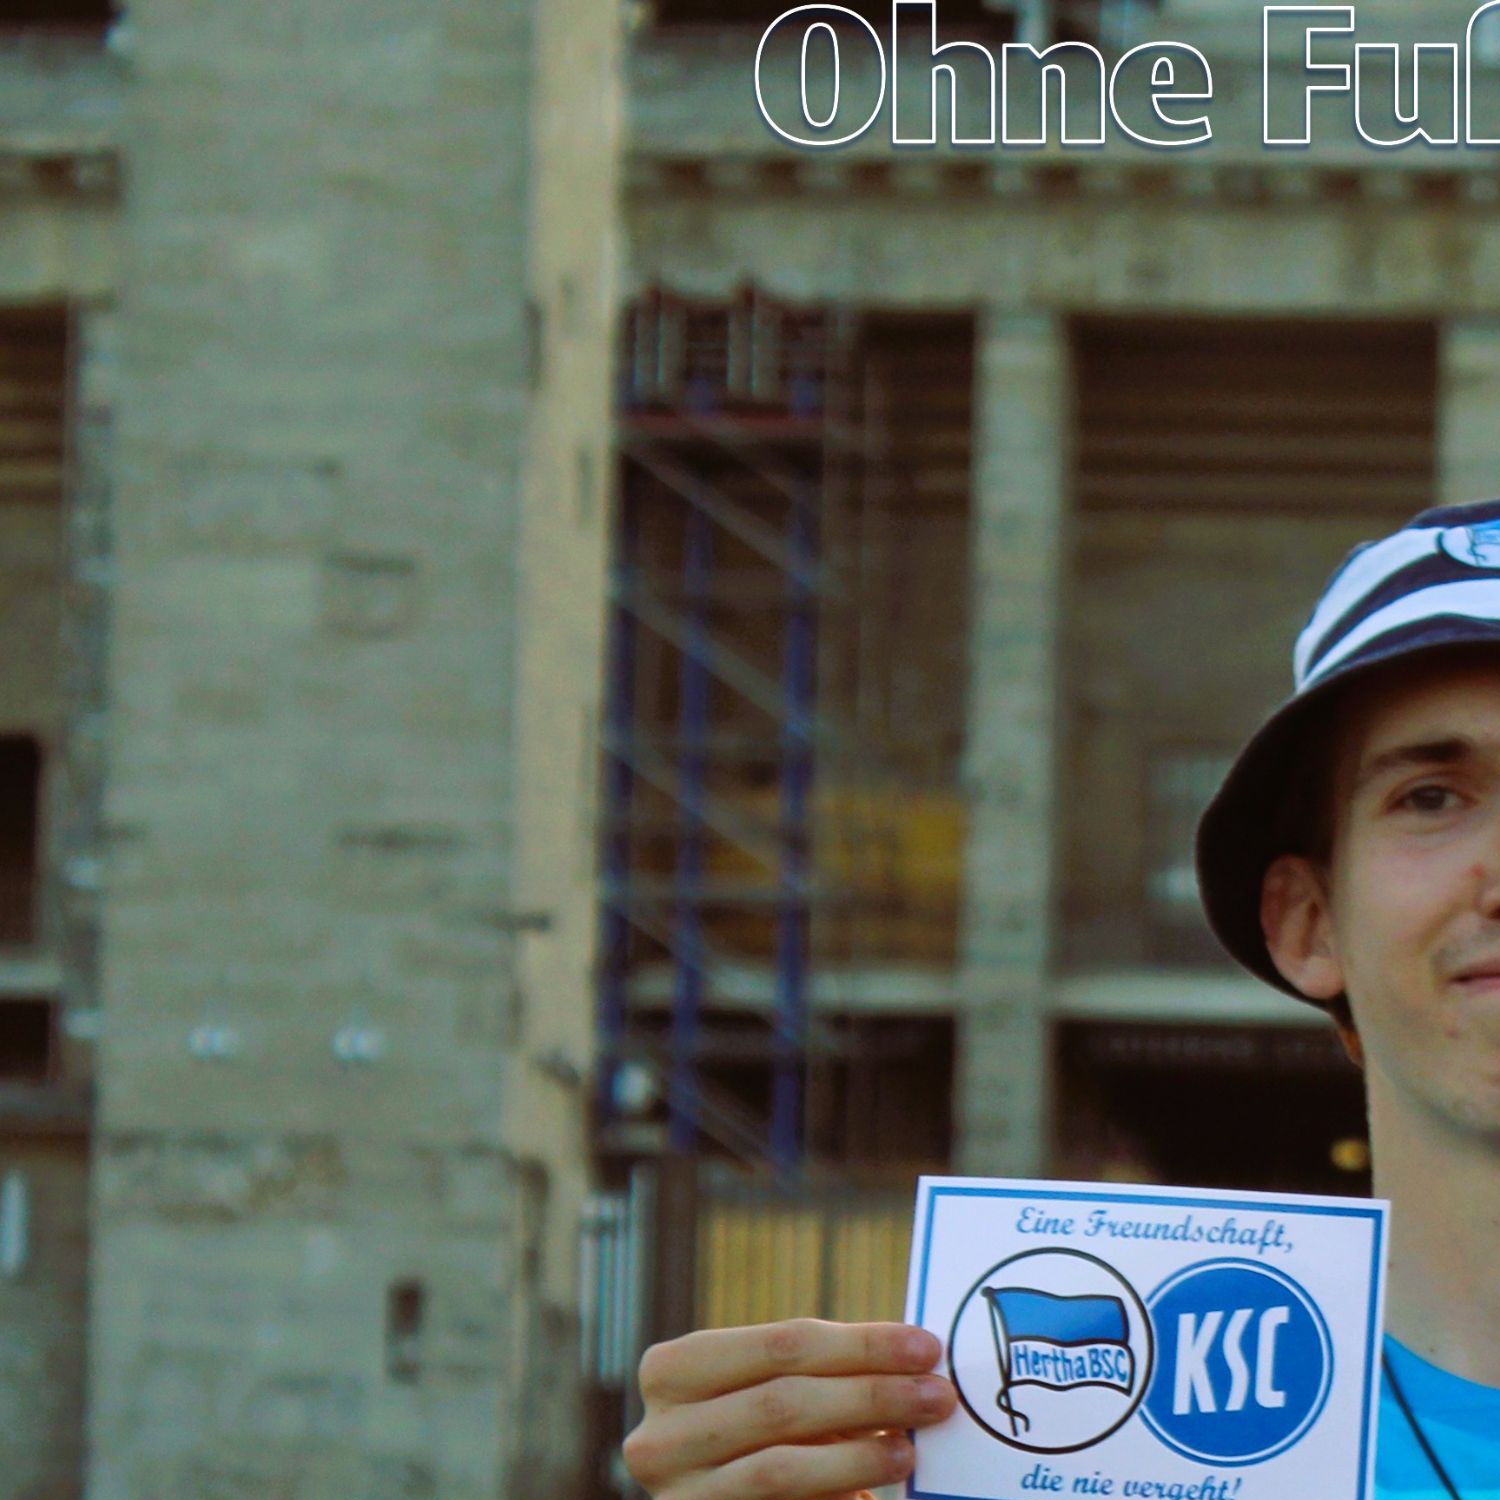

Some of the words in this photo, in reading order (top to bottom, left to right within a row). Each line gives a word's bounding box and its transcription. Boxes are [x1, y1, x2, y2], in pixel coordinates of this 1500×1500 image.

[1016, 1206, 1074, 1236] Eine
[1084, 1209, 1293, 1255] Freundschaft,
[1172, 1306, 1290, 1416] KSC
[1021, 1463, 1063, 1492] die
[1072, 1471, 1113, 1495] nie
